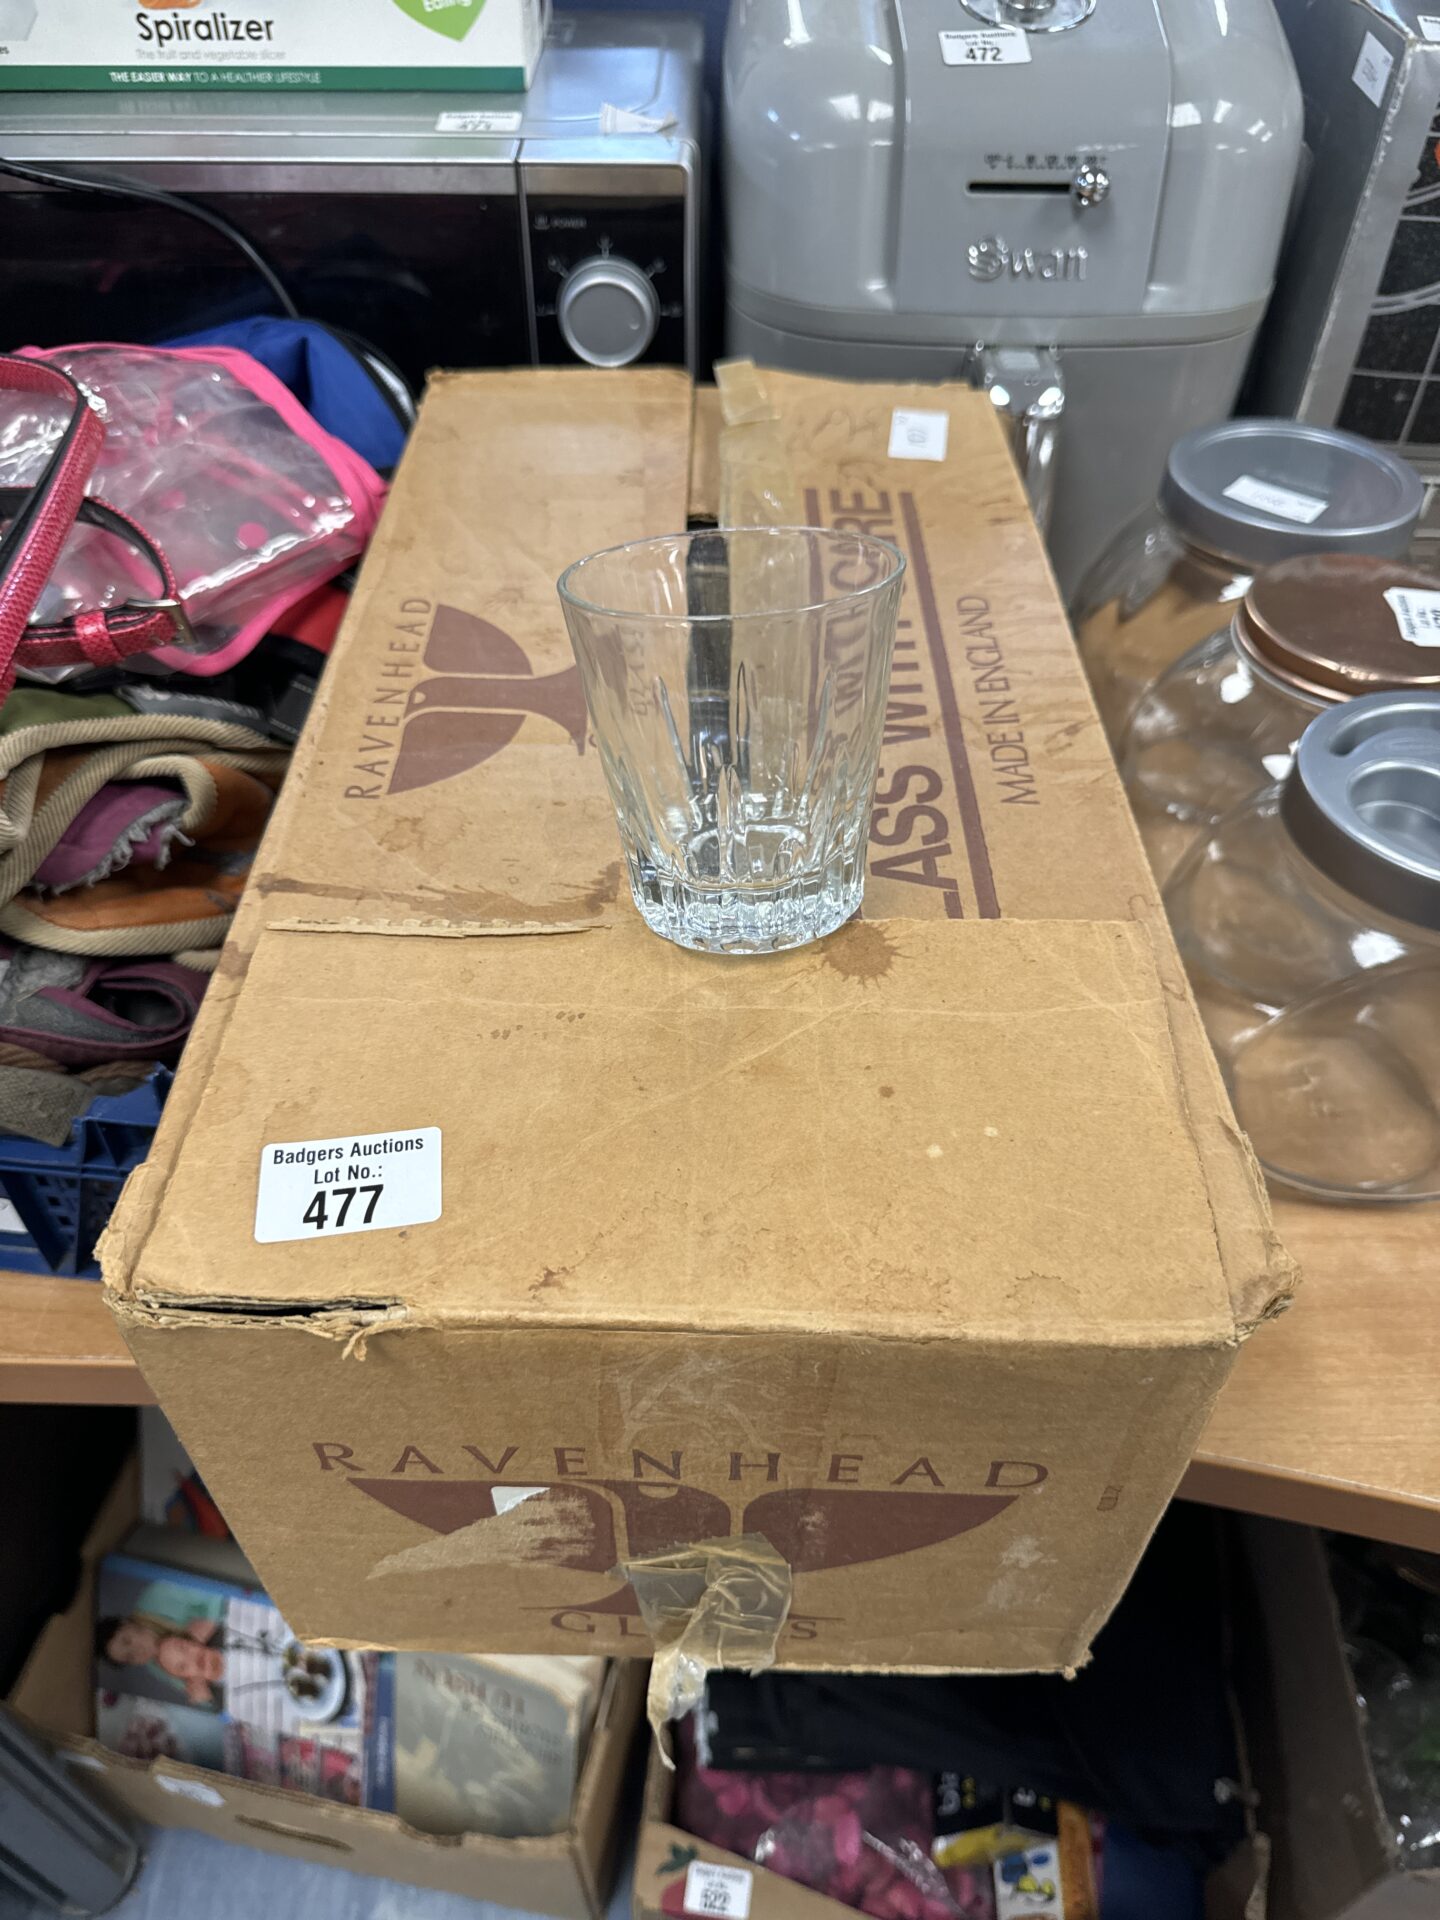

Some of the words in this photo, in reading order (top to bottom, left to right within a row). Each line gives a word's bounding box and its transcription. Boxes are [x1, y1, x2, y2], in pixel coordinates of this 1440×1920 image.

[136, 12, 274, 47] Spiralizer
[965, 47, 1003, 62] 472
[109, 71, 129, 83] THE
[131, 71, 165, 83] EASIER
[166, 71, 193, 83] WAY
[193, 72, 209, 83] TO
[211, 72, 221, 83] A
[221, 72, 273, 83] HEALTHIER
[275, 72, 321, 83] LIFESTYLE
[968, 235, 1088, 282] Swan
[956, 595, 1010, 693] ENGLAND
[344, 598, 433, 801] RAVENHEAD
[978, 700, 1021, 725] IN
[987, 731, 1040, 805] MADE
[273, 1147, 344, 1166] Badgers
[350, 1137, 424, 1158] Auctions
[314, 1167, 340, 1184] Lot
[347, 1164, 382, 1181] No.:
[302, 1184, 384, 1230] 477
[312, 1442, 1049, 1487] RAVENHEAD
[551, 1609, 818, 1640] GLS
